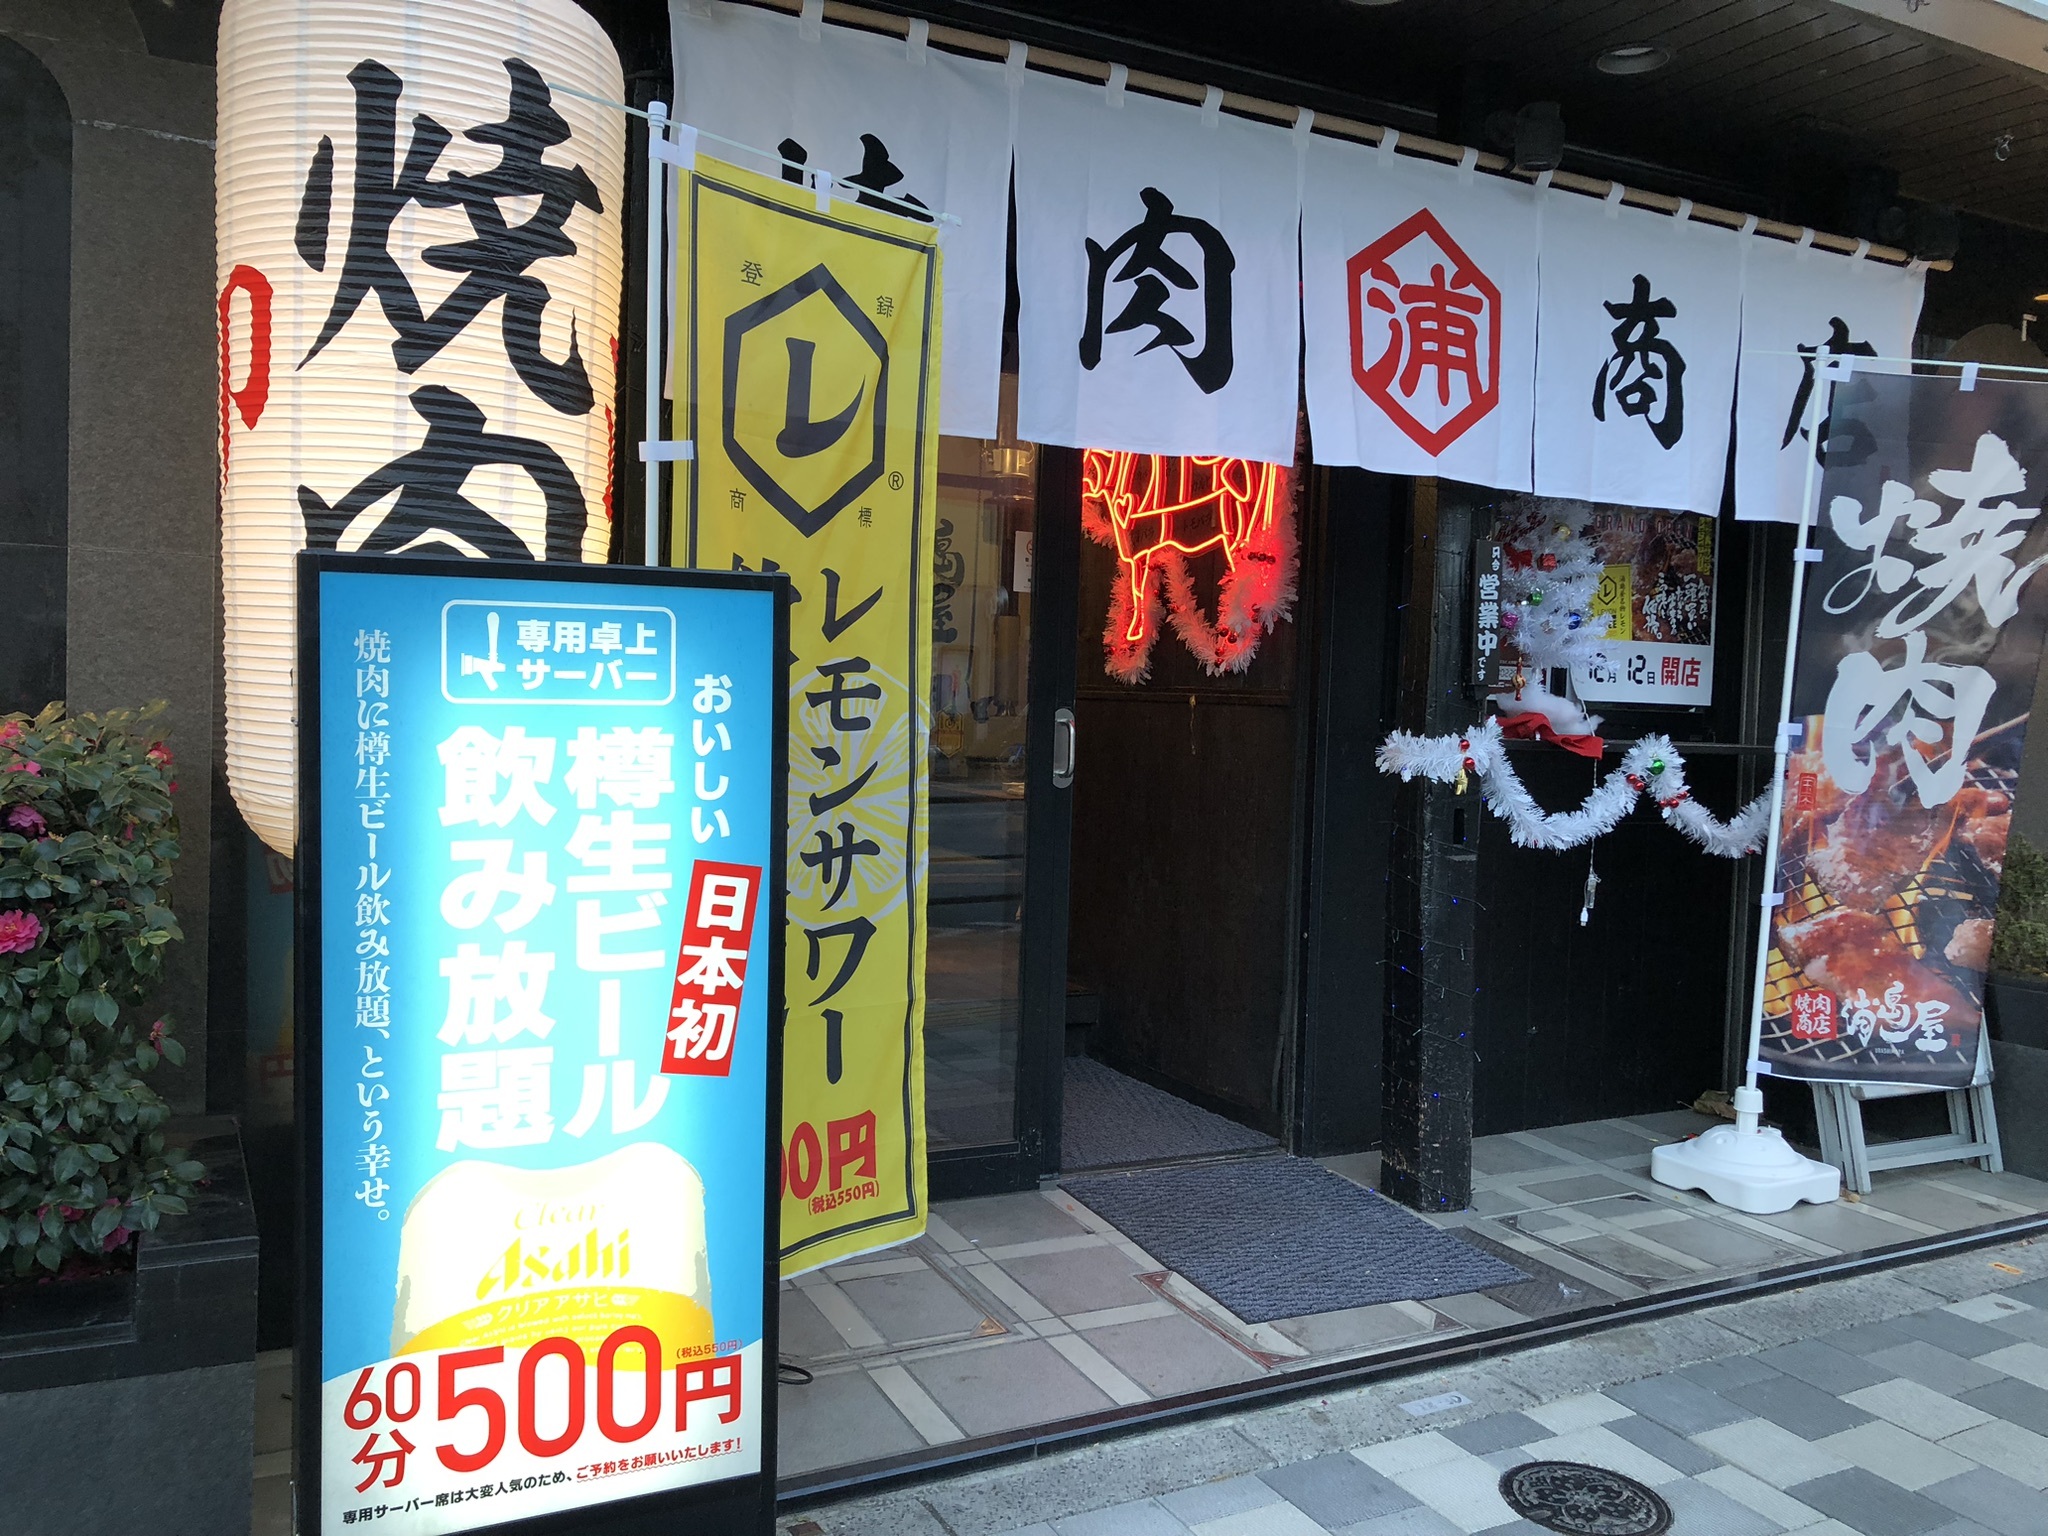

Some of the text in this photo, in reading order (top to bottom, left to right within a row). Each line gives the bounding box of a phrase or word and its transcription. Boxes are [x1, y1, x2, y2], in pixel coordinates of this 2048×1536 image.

[516, 620, 658, 654] 専用卓上
[517, 657, 657, 690] サーバー
[1822, 430, 2048, 810] 焼肉
[690, 674, 733, 845] おいしい
[800, 567, 884, 1086] レモンサワー
[353, 628, 393, 1223] 焼肉に樽生ビール飲み放題、という幸せ。
[434, 725, 559, 1153] 飲み放題
[562, 726, 676, 1139] 樽生ビール
[667, 873, 750, 1063] 日本初
[781, 1109, 877, 1200] 0円
[476, 1227, 631, 1300] Asahi
[343, 1362, 421, 1431] 60
[435, 1324, 743, 1475] 500円
[676, 1338, 743, 1359] (税込550円)
[351, 1429, 417, 1494] 分
